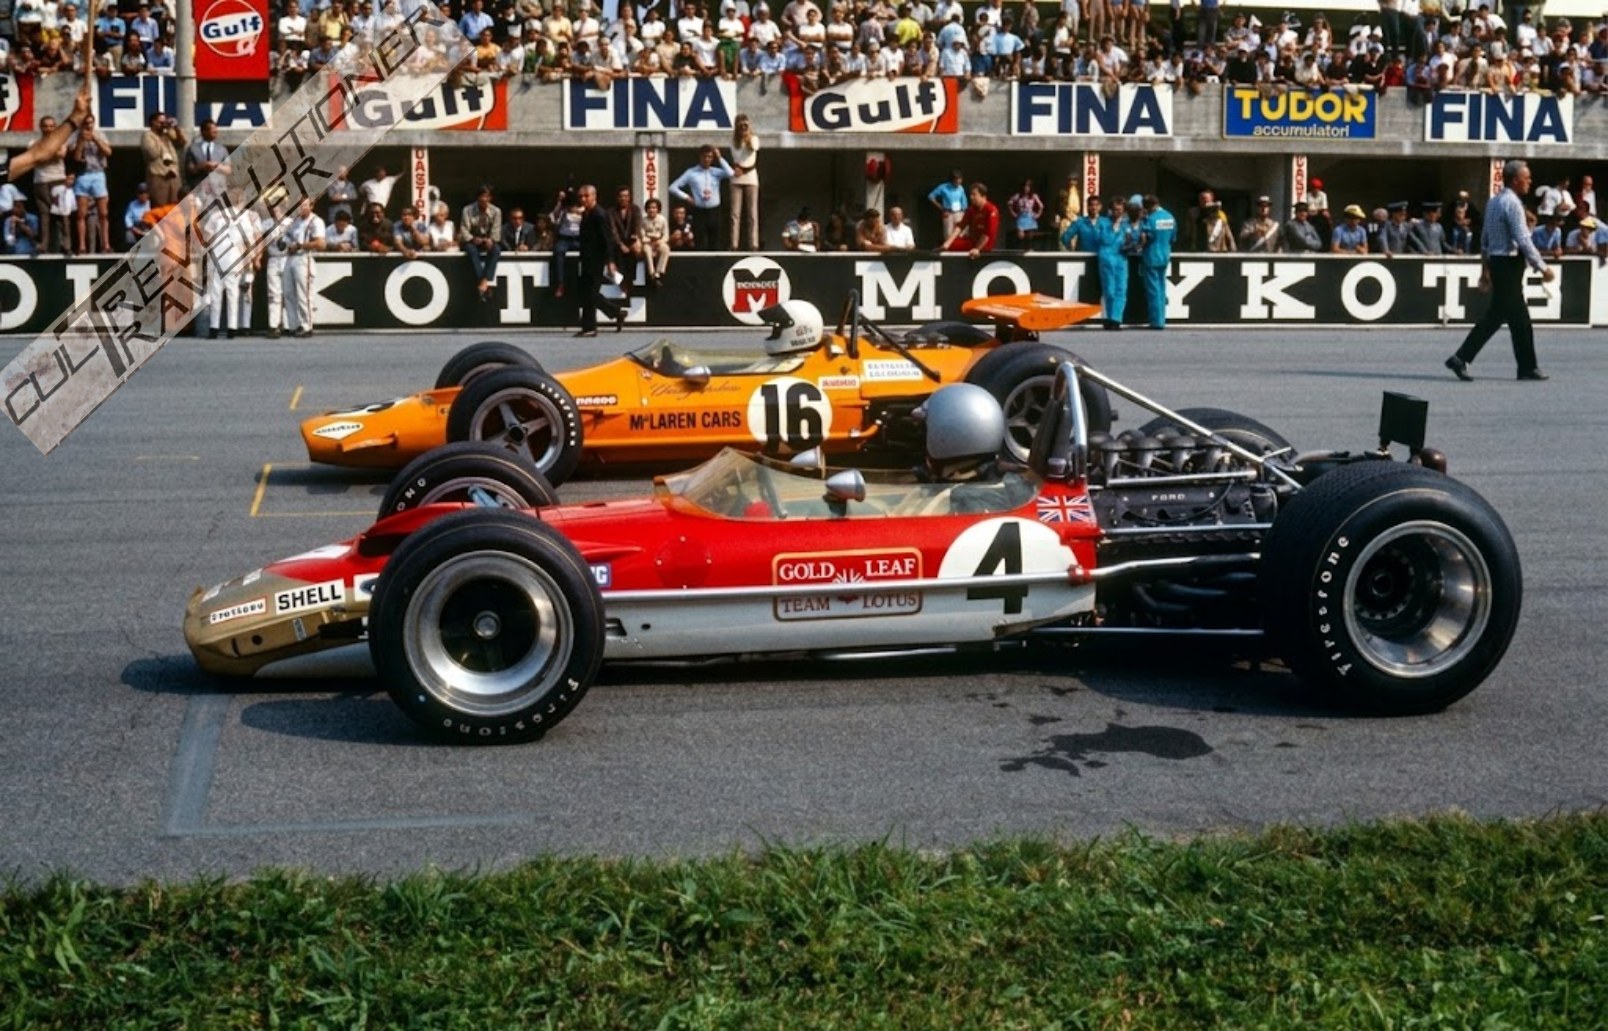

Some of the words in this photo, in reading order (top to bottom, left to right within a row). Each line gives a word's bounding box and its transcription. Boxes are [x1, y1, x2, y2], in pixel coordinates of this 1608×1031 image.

[203, 15, 260, 38] Gulf
[352, 80, 484, 128] Gulf
[570, 78, 732, 127] FINA
[811, 82, 937, 129] Gulf
[1017, 84, 1167, 134] FINA
[1234, 88, 1367, 123] TUDOR
[1431, 93, 1567, 142] FINA
[1253, 122, 1349, 137] accumulatori
[701, 411, 741, 428] CARS
[761, 382, 824, 452] 16
[1152, 493, 1186, 501] FORD
[779, 562, 835, 581] GOLD
[865, 558, 916, 577] LEAF
[967, 521, 1029, 614] 4
[278, 584, 342, 611] SHELL
[781, 597, 830, 613] TEAM
[862, 593, 917, 609] LOTUS
